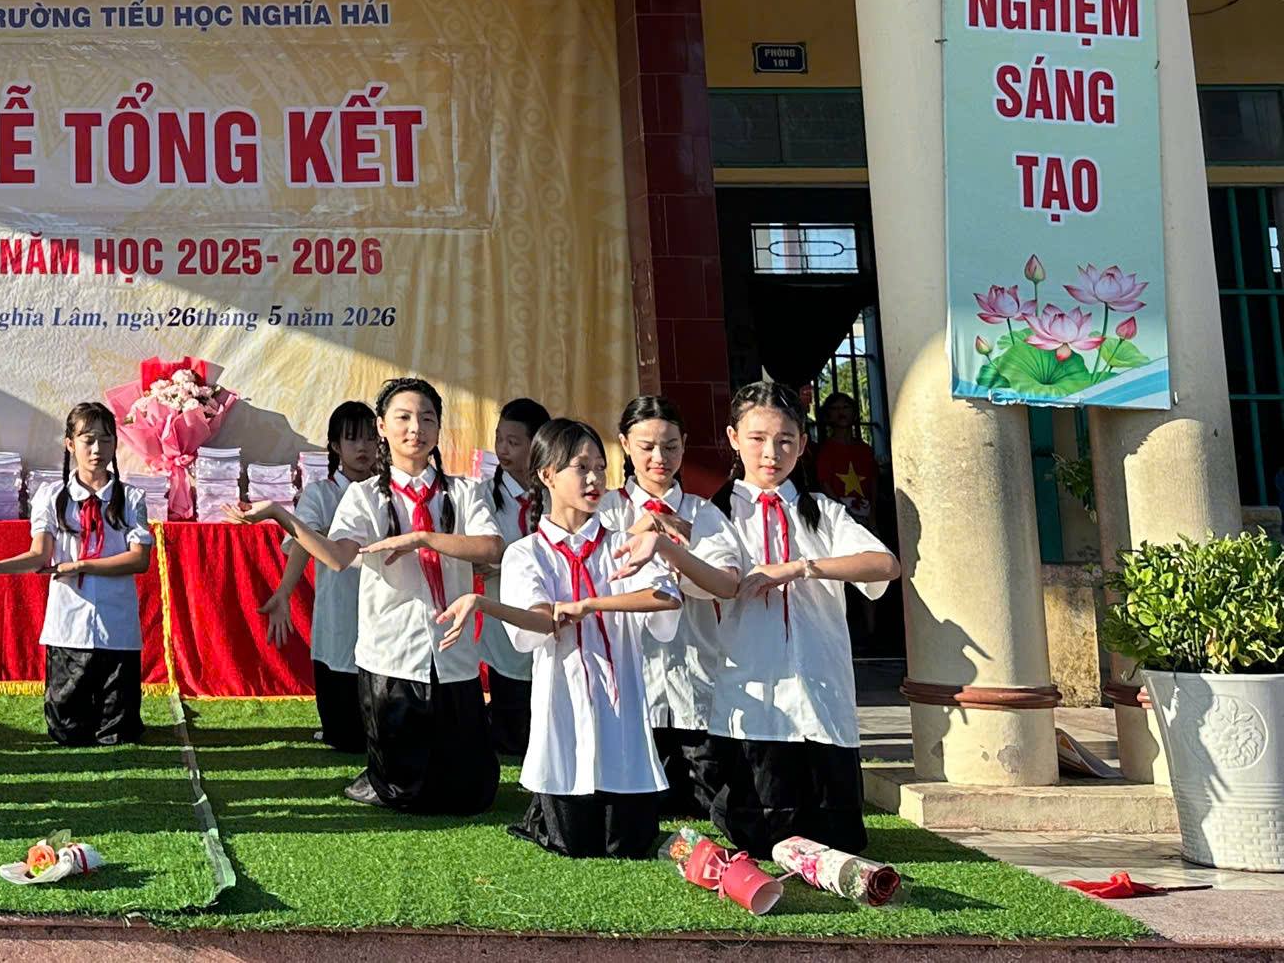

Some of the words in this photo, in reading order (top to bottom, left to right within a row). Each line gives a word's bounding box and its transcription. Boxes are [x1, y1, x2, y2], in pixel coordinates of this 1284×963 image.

[174, 4, 233, 32] HỌC
[242, 0, 332, 26] NGHĨA
[996, 55, 1115, 124] SÁNG
[64, 82, 258, 184] TỔNG
[287, 85, 423, 183] KẾT
[1016, 153, 1100, 223] TẠO
[0, 231, 80, 275] NĂM
[94, 237, 164, 283] HỌC
[292, 237, 384, 275] 2026
[51, 307, 108, 328] Lâm,
[268, 305, 283, 326] 5
[286, 306, 334, 326] năm
[341, 306, 396, 327] 2026
